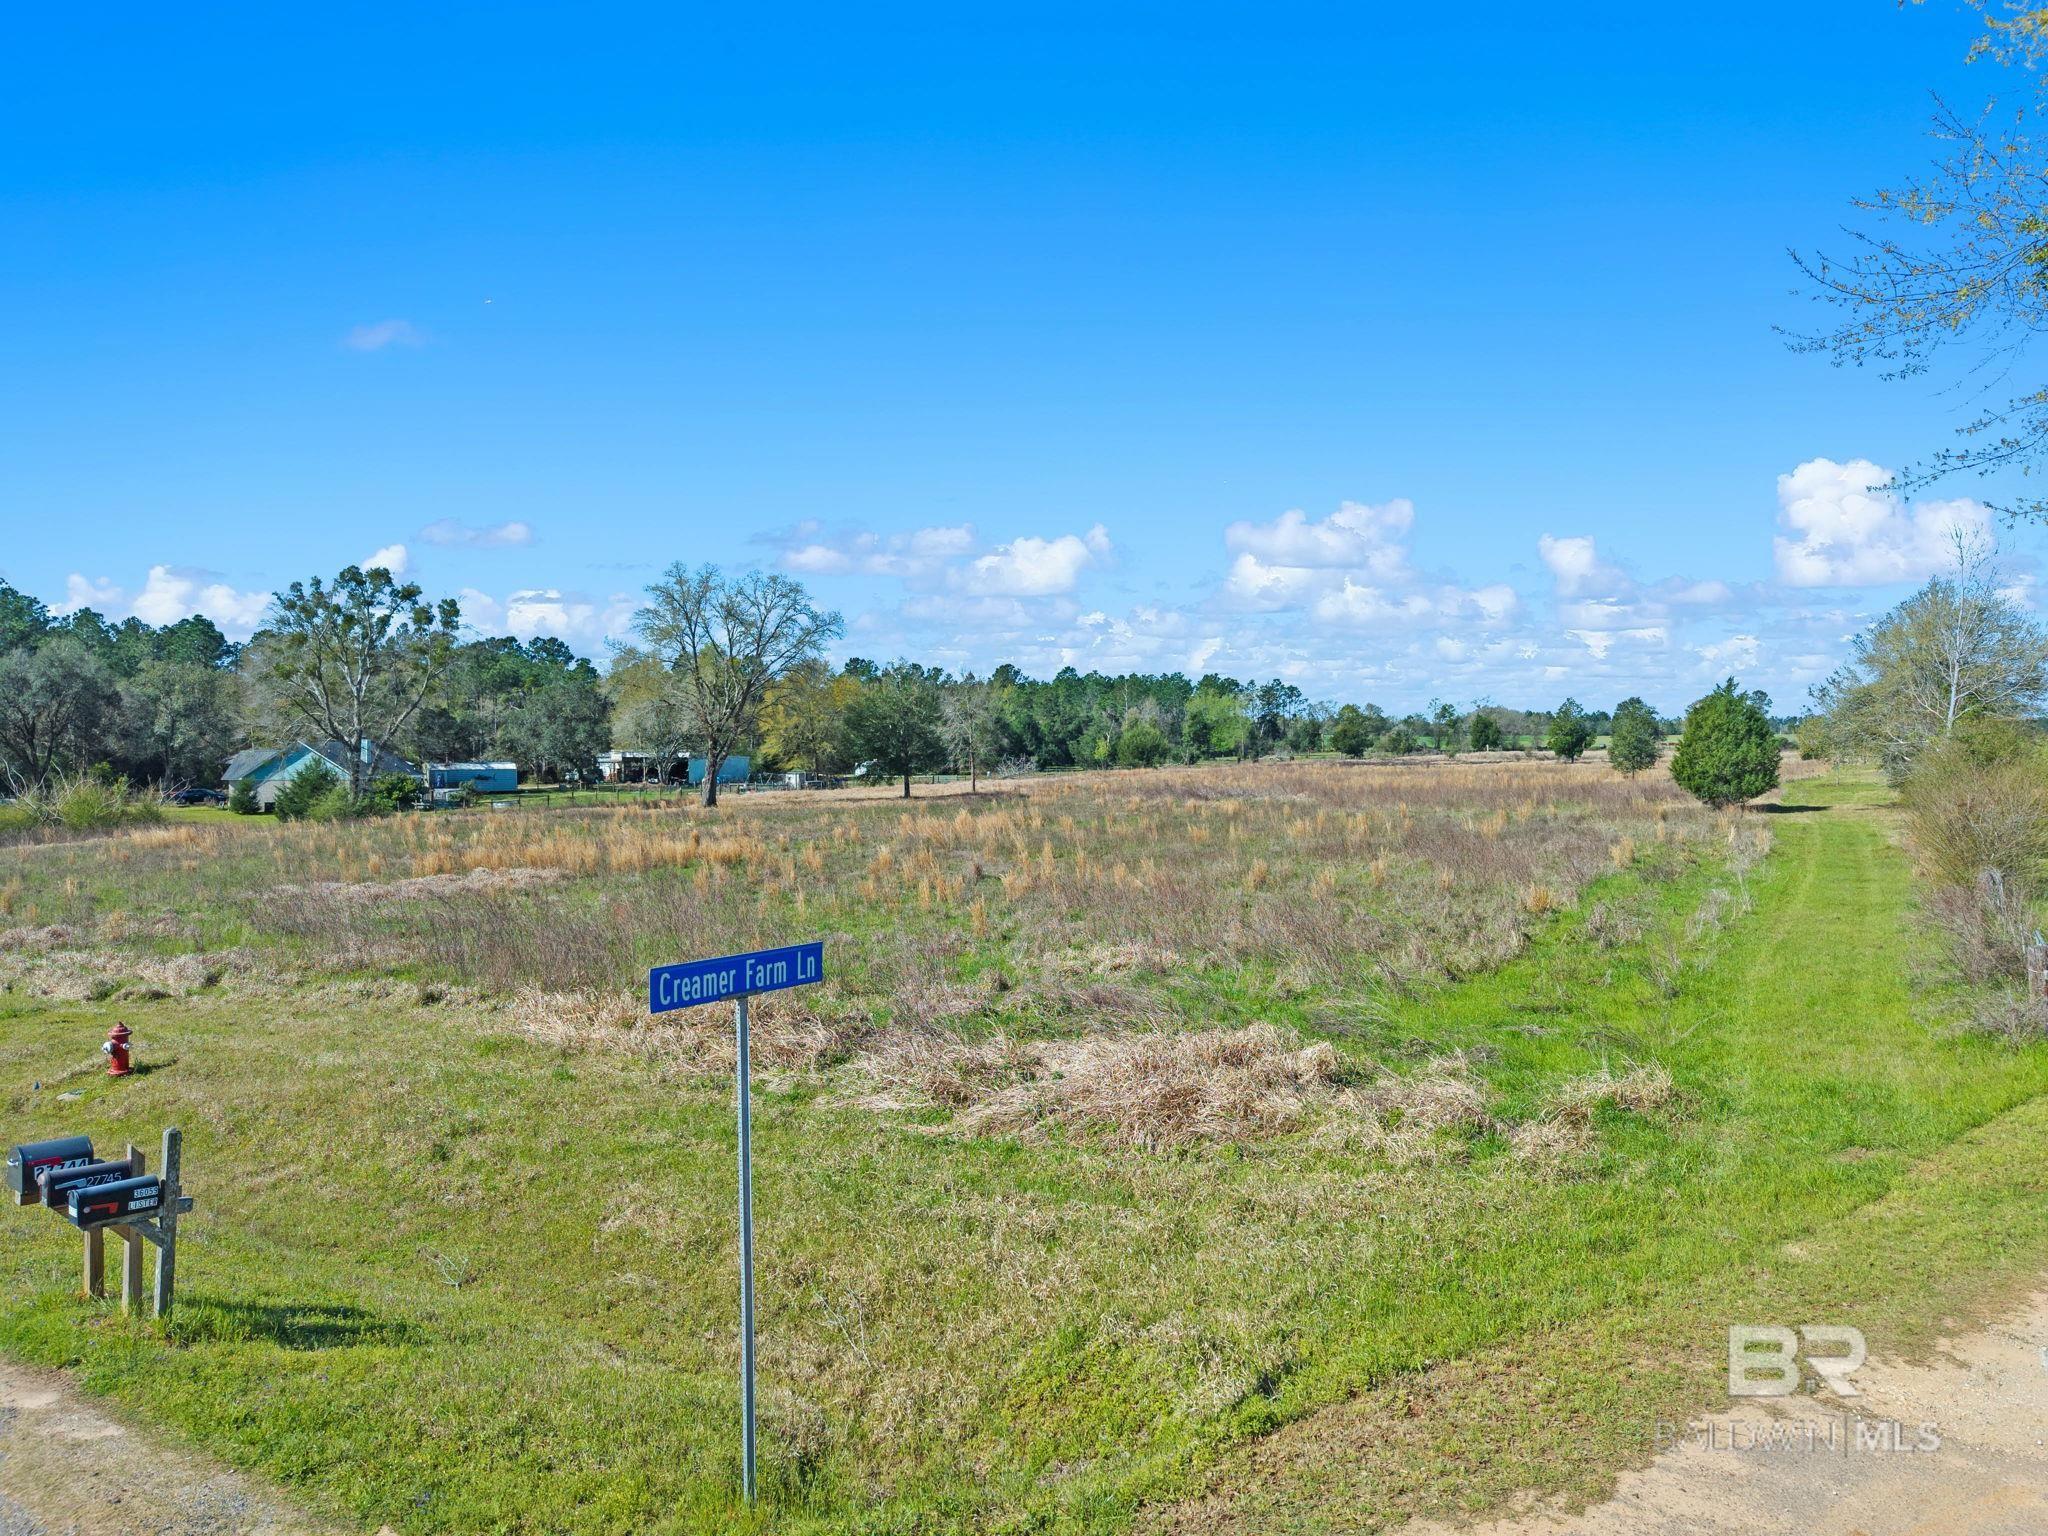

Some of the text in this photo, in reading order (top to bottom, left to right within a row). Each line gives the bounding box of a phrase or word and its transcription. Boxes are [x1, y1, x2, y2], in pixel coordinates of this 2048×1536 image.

[659, 952, 815, 1006] Creamer Farm Ln
[86, 1173, 122, 1188] 27745
